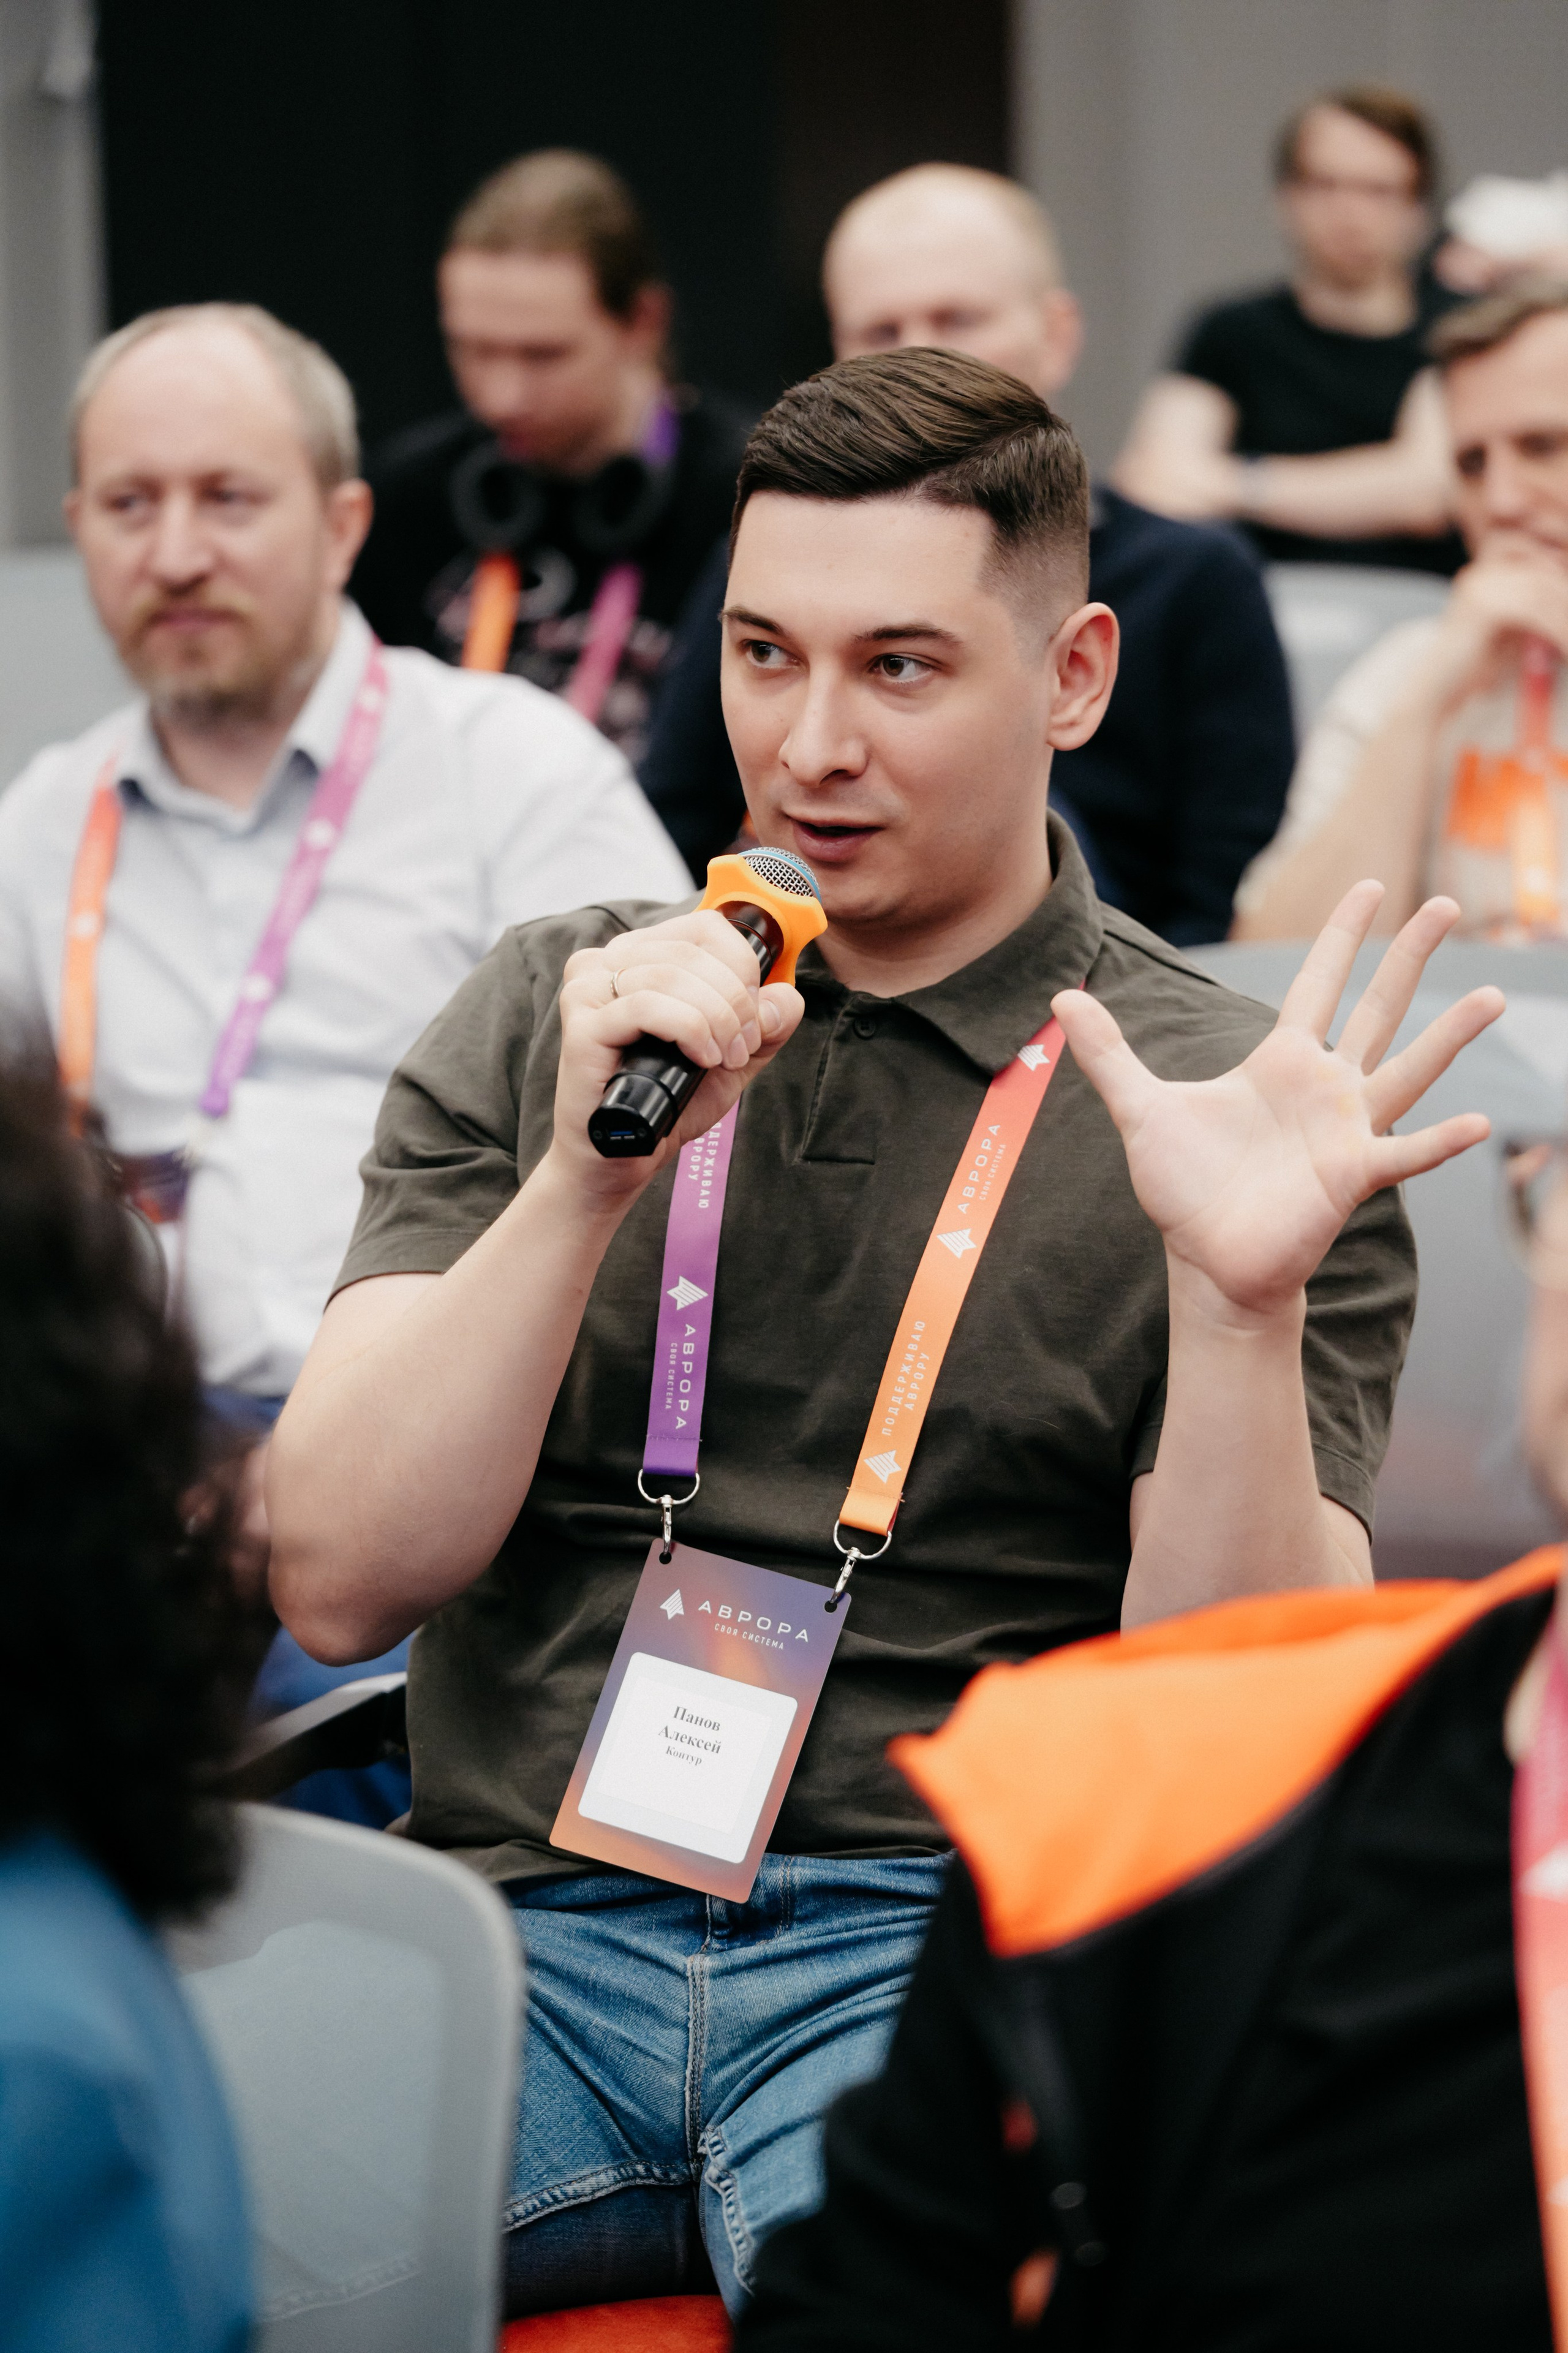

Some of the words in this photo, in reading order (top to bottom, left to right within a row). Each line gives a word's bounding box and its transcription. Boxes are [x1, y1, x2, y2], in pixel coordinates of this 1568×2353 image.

[688, 1138, 705, 1180] ВРОРУ
[698, 1122, 722, 1209] ДДЕРЖИВАЮ
[957, 1124, 1001, 1215] АВРОРА
[675, 1323, 696, 1430] АВРОРА
[881, 1320, 925, 1436] ПОДДЕРЖИВАЮ
[904, 1353, 929, 1411] АВРОРУ
[698, 1600, 809, 1642] АВРОРА
[714, 1623, 738, 1636] СВОЯ
[742, 1631, 784, 1650] СИСТЕМА
[658, 1724, 722, 1754] Алексей
[673, 1705, 720, 1731] Панов
[666, 1745, 702, 1766] Контур
